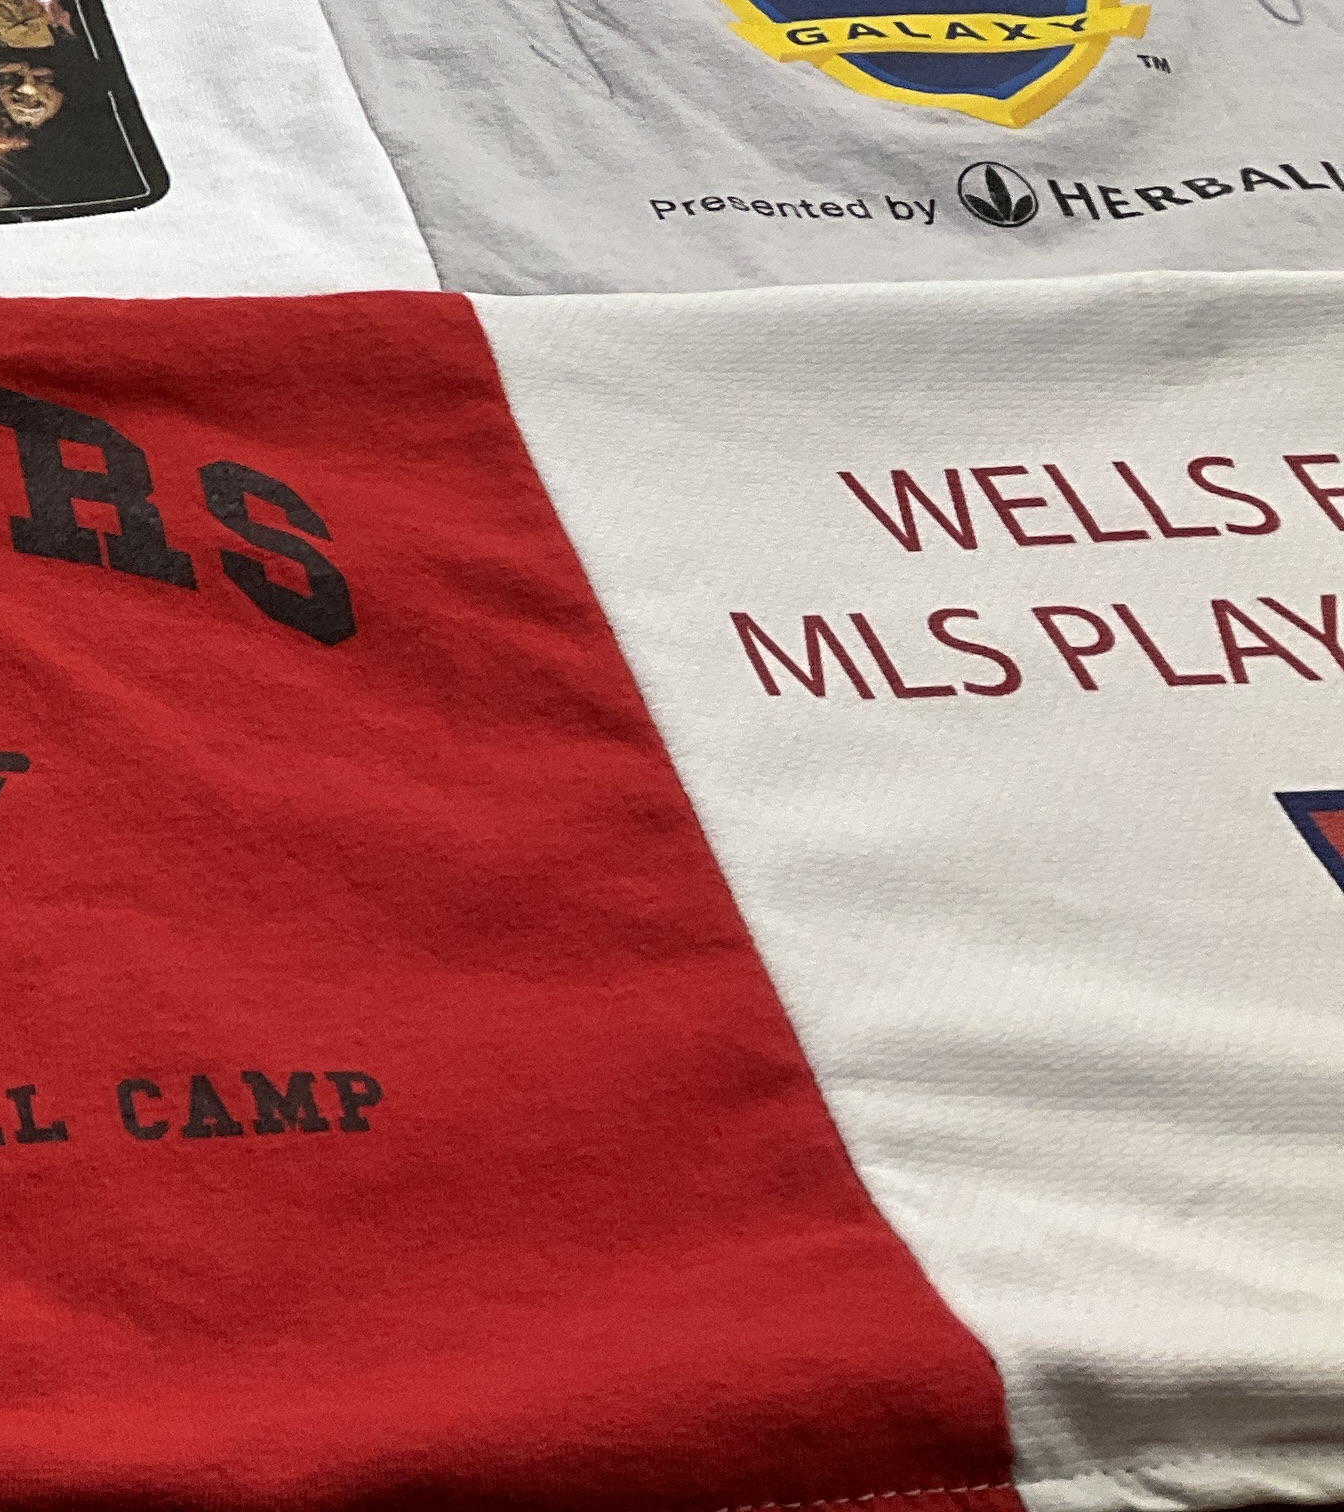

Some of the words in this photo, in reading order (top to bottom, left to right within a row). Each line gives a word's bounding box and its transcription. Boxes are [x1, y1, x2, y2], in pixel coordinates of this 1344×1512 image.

[786, 17, 1089, 46] GALAXY
[885, 194, 938, 226] by
[836, 454, 1282, 553] WELLS
[728, 606, 1024, 700] MLS
[1029, 593, 1344, 693] PLAY
[114, 1067, 386, 1142] CAMP
